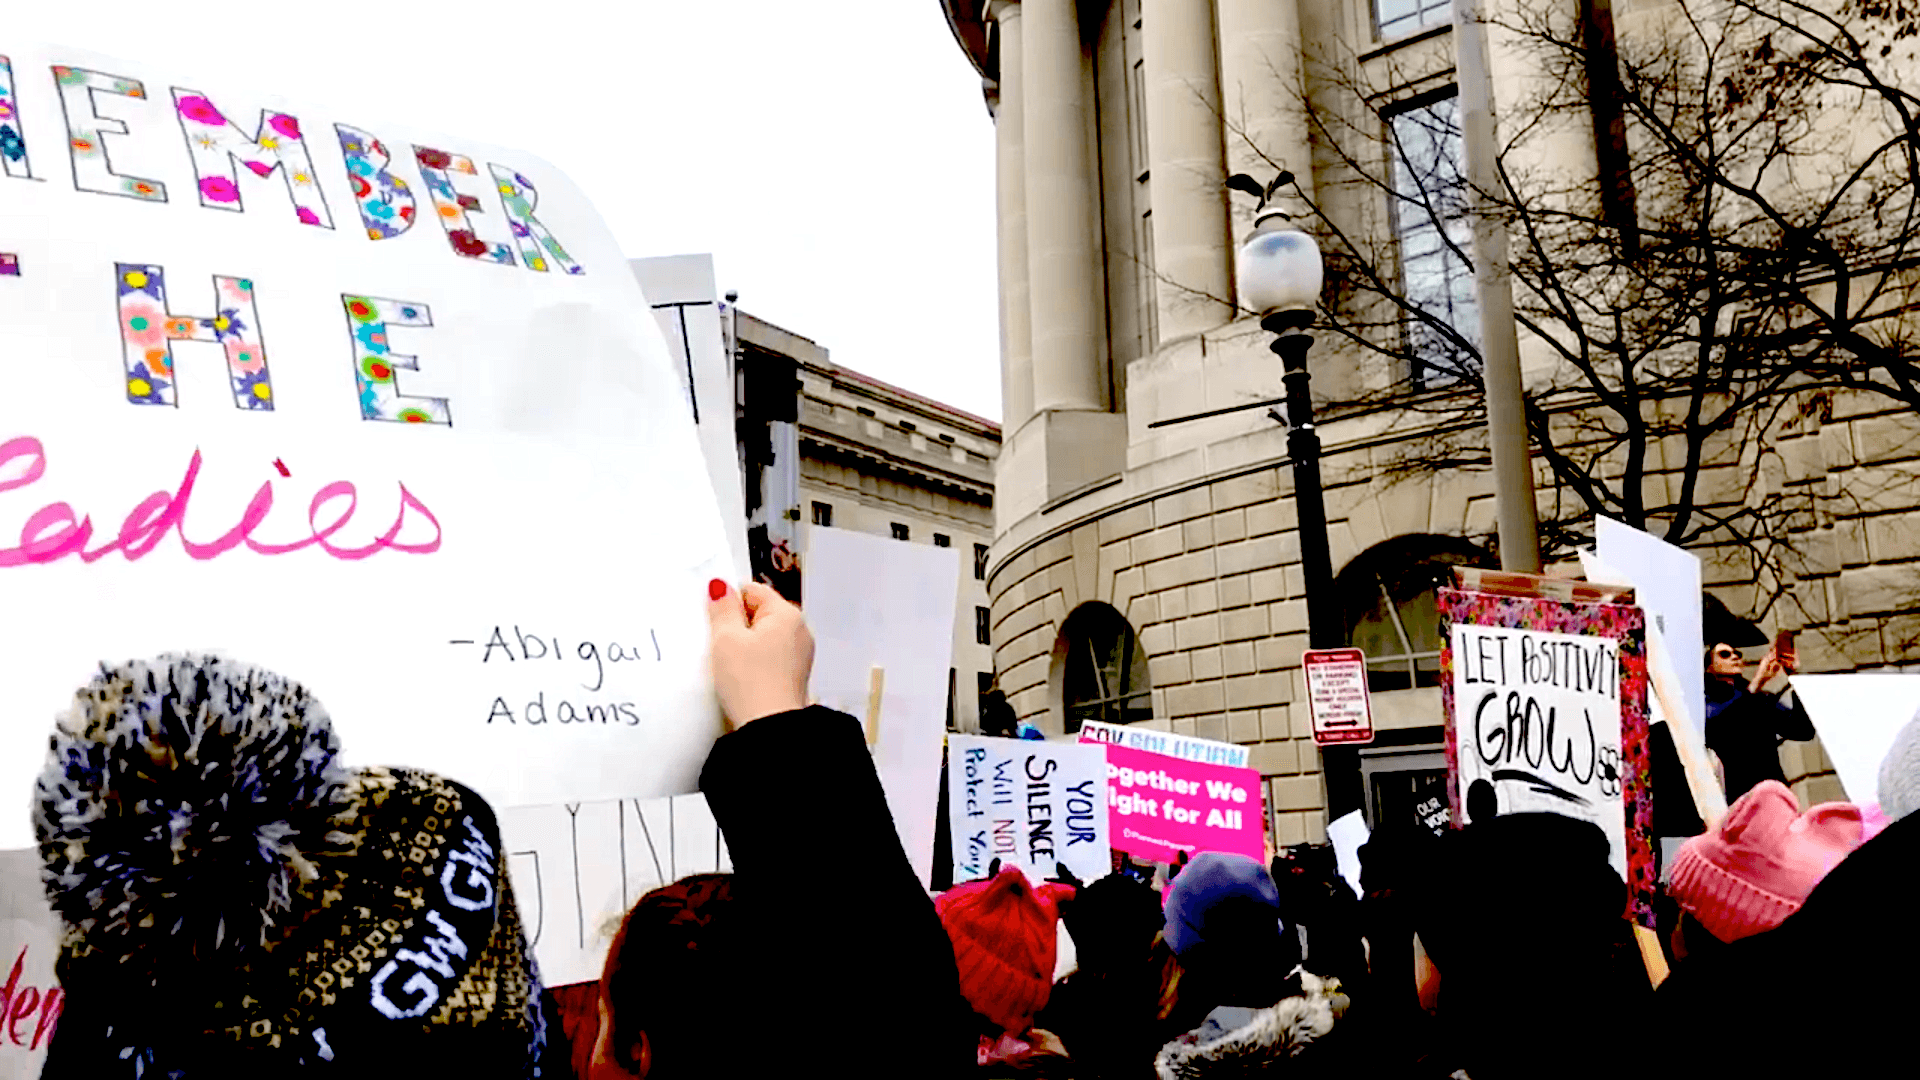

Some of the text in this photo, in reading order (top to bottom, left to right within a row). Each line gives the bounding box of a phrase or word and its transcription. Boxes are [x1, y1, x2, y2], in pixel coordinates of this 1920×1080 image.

[0, 252, 453, 428] HE
[1461, 632, 1509, 686] LET
[487, 691, 641, 736] Adams
[1475, 690, 1596, 786] GROW
[965, 748, 987, 819] Protect
[992, 758, 1013, 805] Will
[1024, 754, 1058, 865] SILENCE
[1065, 780, 1097, 847] YOUR
[1105, 763, 1248, 804] ogether We
[1108, 785, 1243, 831] ight for All
[369, 815, 495, 1020] GW GW
